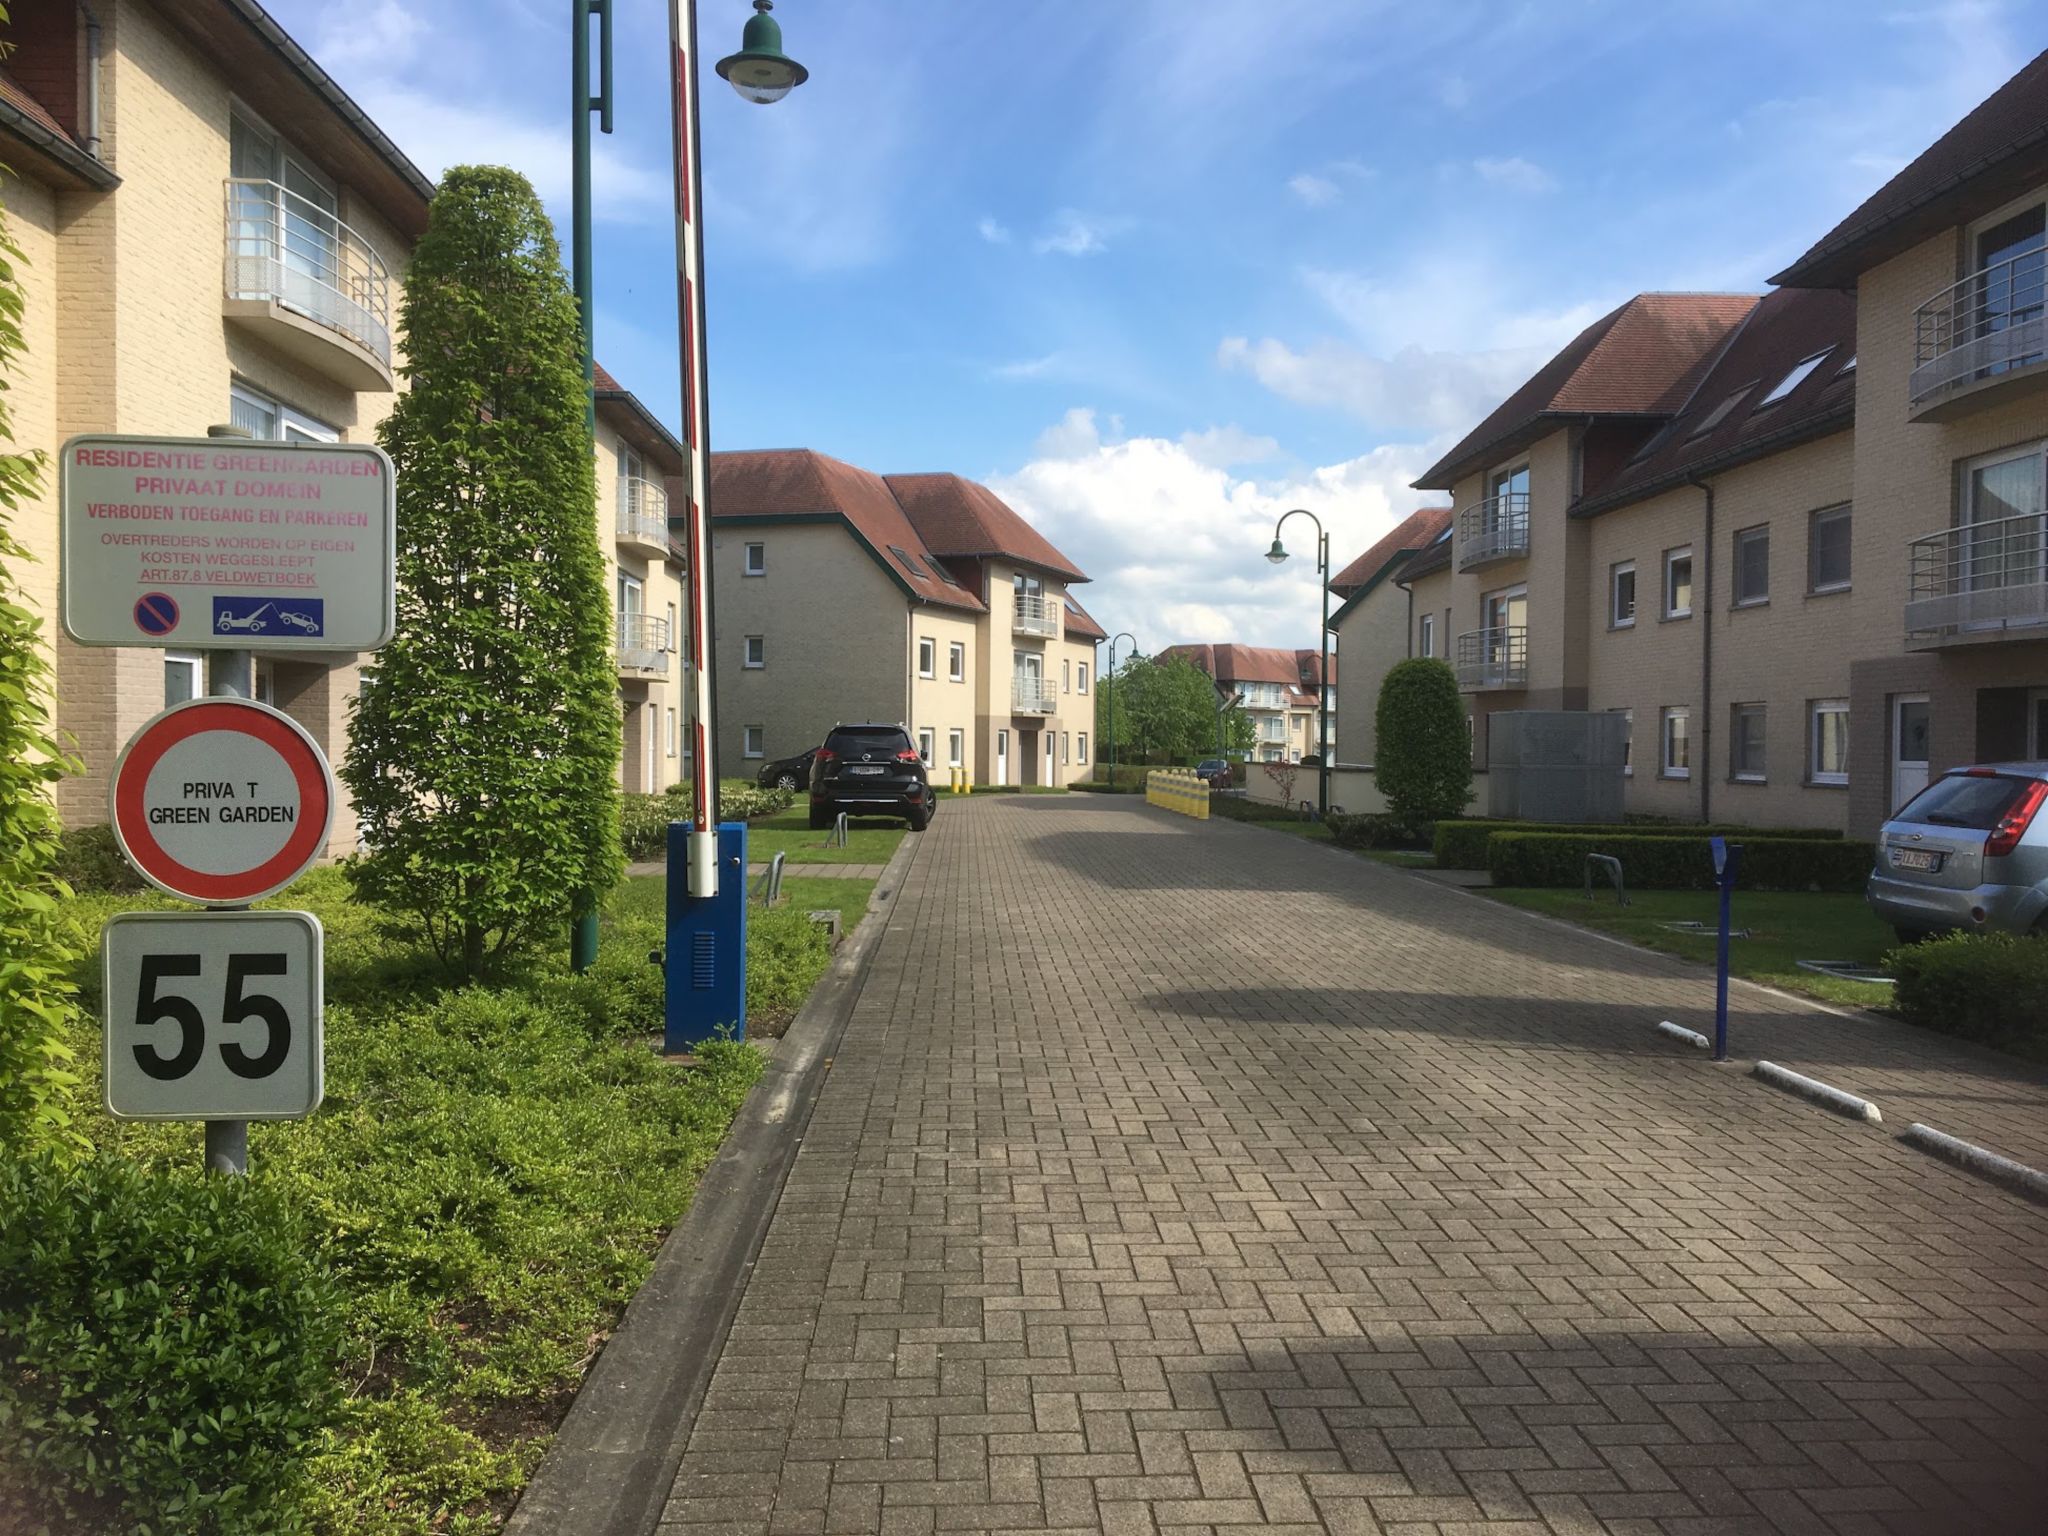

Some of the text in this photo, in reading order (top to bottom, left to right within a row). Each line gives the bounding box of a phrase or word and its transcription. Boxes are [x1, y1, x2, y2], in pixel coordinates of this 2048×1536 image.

[76, 449, 206, 470] RESIDENTIE
[135, 477, 321, 500] PRIVAAT DOMEIN
[87, 503, 368, 527] VERBODEN TOEGANG EN PARKEREN
[101, 533, 355, 552] OVERTREDERS WORDEN OP EIGEN
[141, 551, 201, 564] KOSTEN
[140, 569, 316, 584] ART.87.8 VELDWETBOEK
[150, 806, 294, 824] GREEN GARDEN
[132, 953, 291, 1080] 55
